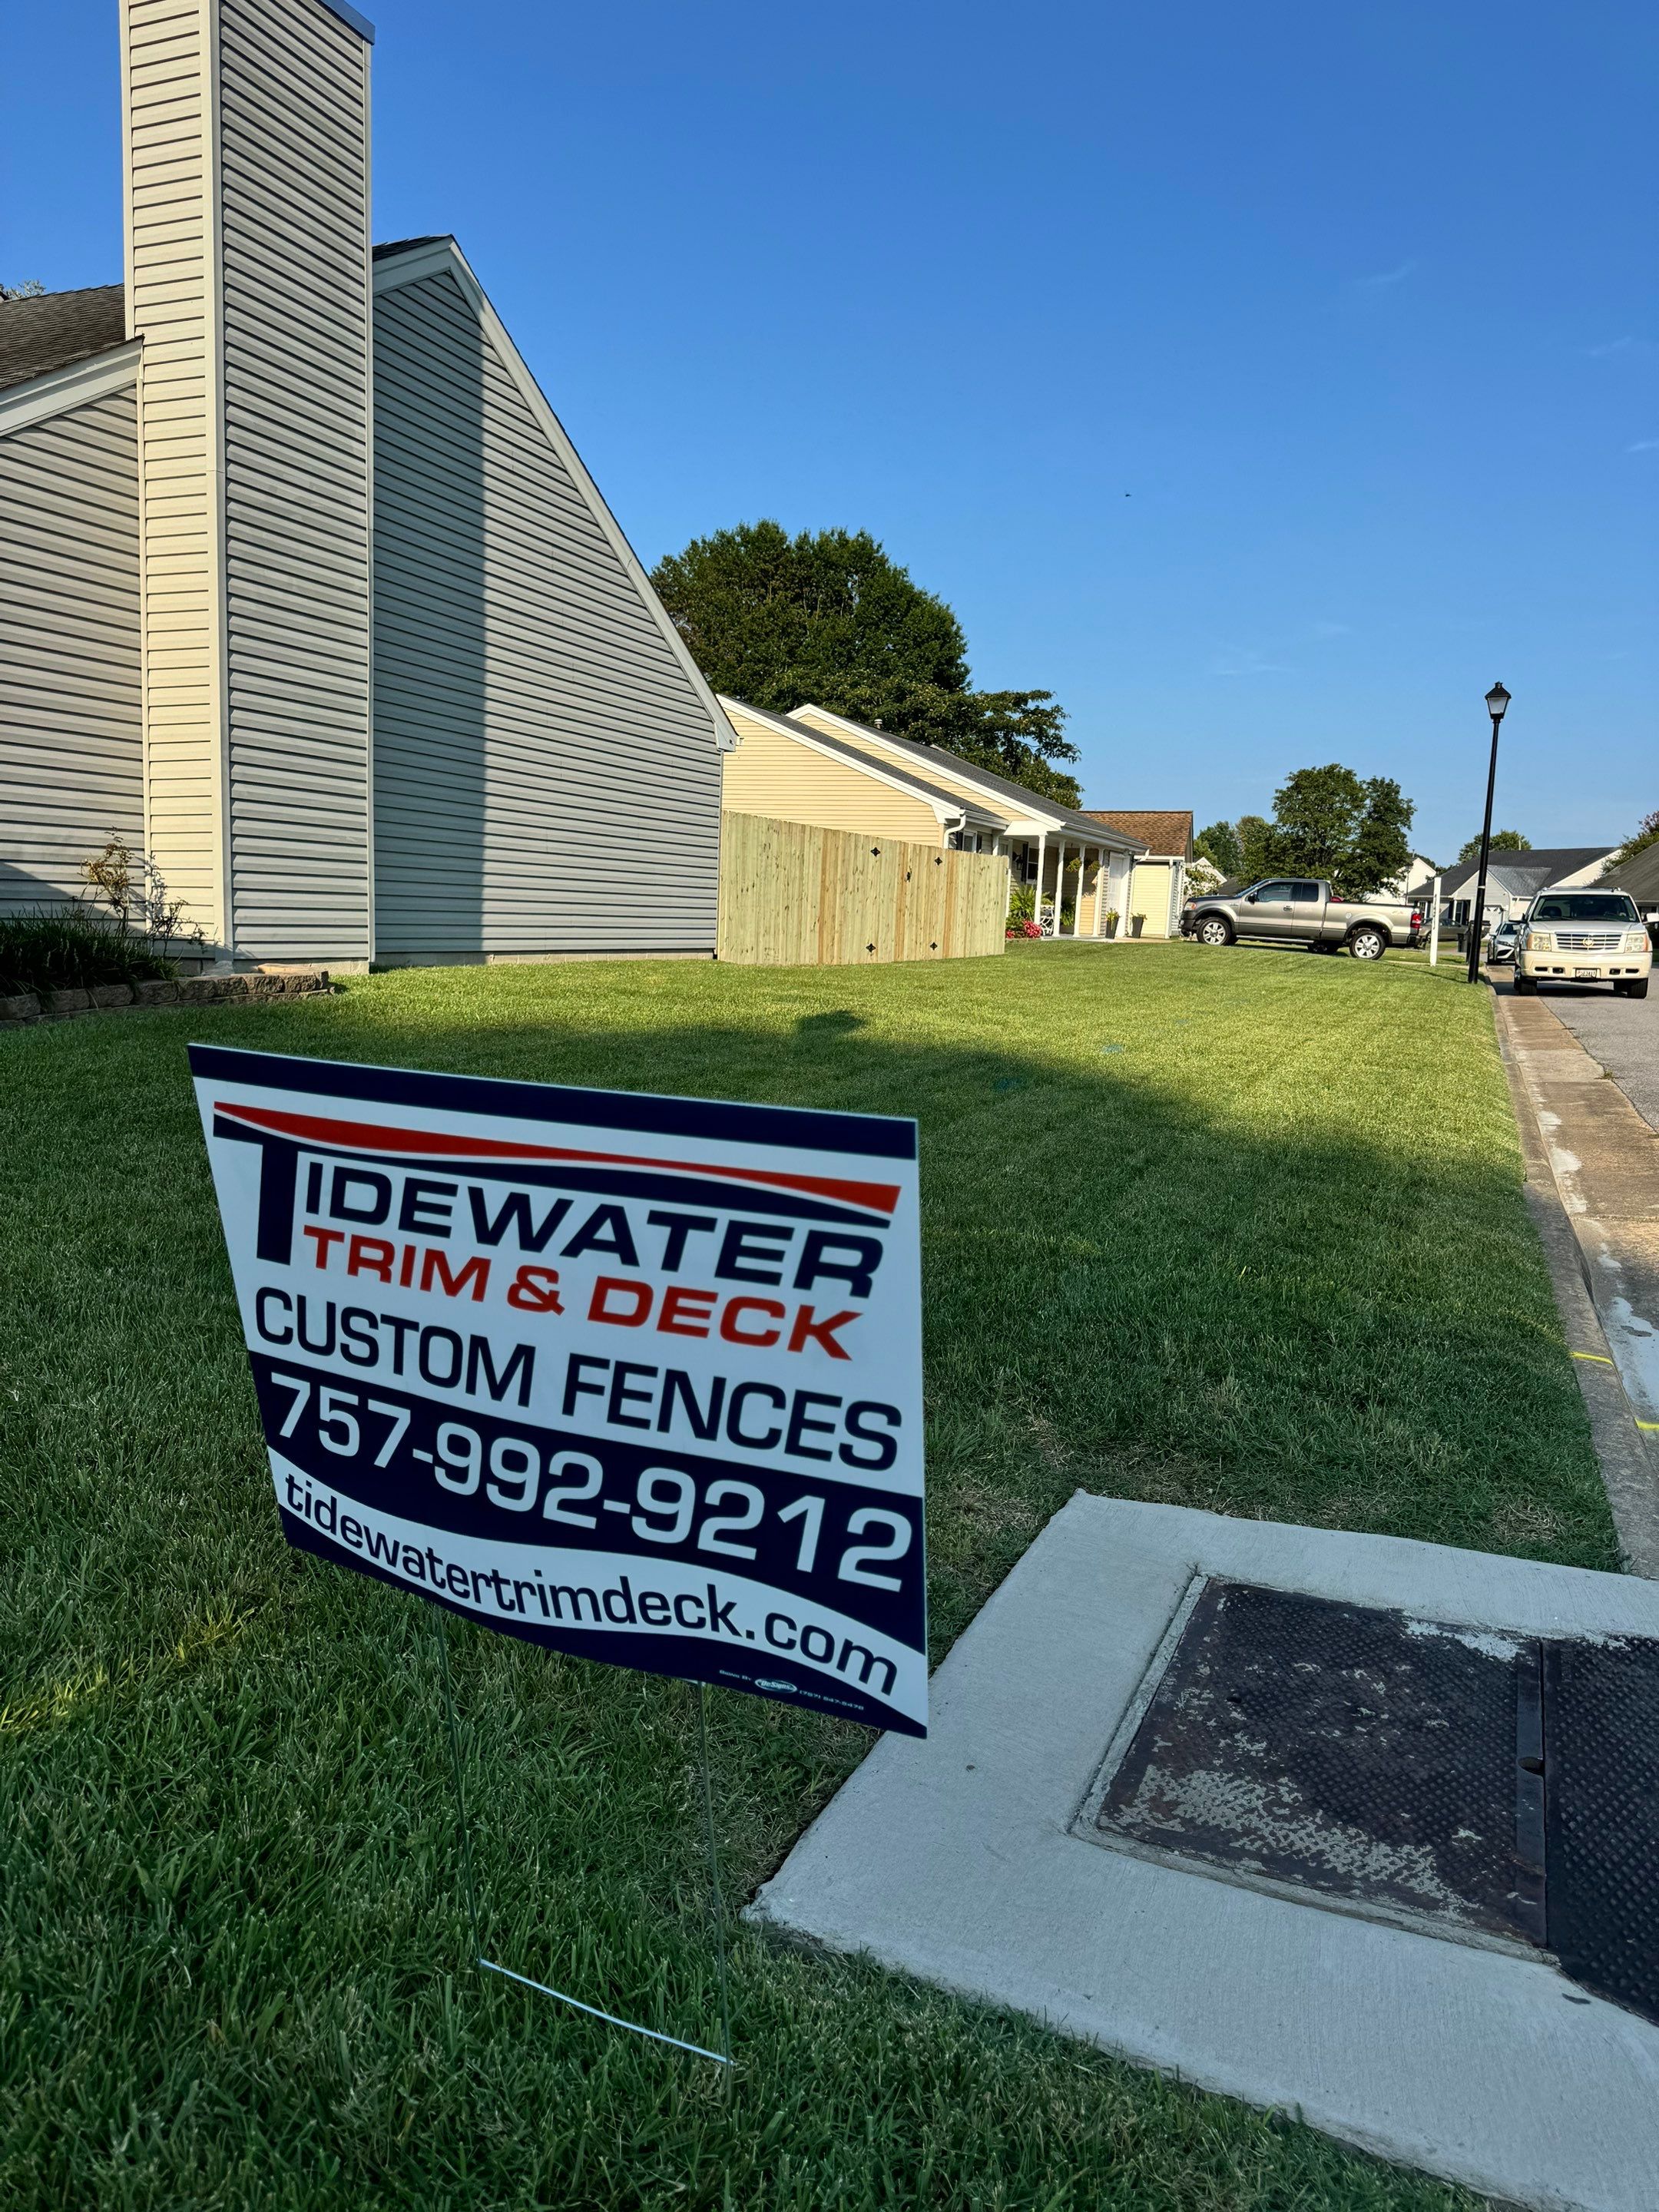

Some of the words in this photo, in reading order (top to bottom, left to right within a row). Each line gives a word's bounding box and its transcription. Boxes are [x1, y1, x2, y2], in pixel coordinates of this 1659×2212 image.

[213, 1113, 892, 1299] TIDEWATER
[303, 1224, 492, 1303] TRIM
[507, 1264, 565, 1316] &
[587, 1276, 863, 1361] DECK
[256, 1286, 536, 1408] CUSTOM
[561, 1353, 902, 1472] FENCES
[271, 1371, 912, 1593] 757-992-9212
[285, 1473, 898, 1697] tidewatertrimdeck.com
